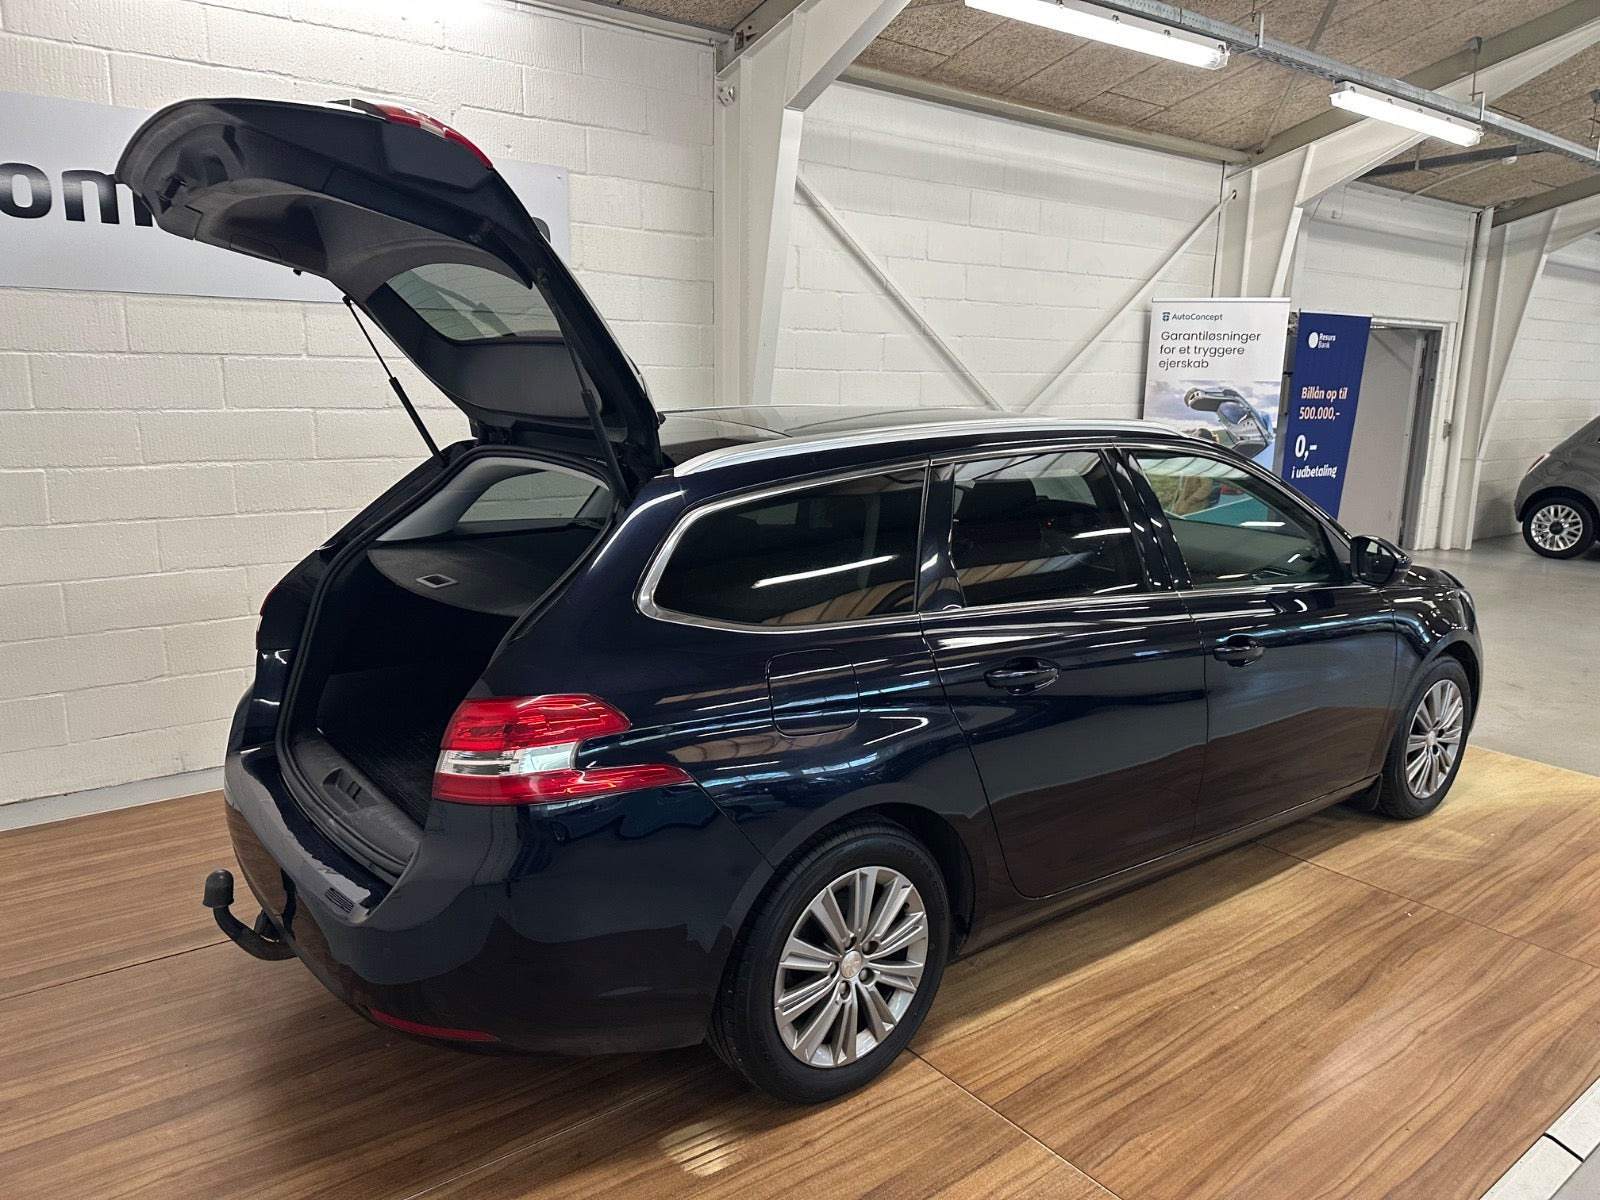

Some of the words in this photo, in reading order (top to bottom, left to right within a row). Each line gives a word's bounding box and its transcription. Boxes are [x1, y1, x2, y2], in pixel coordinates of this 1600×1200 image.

[1172, 313, 1223, 322] AutoConcept
[1161, 331, 1261, 344] Garantiløsninger
[1319, 332, 1336, 342] Resurs
[1160, 344, 1176, 355] for
[1178, 345, 1191, 355] et
[1194, 345, 1245, 358] tryggere
[1318, 340, 1331, 349] Bank
[1158, 359, 1209, 371] ejerskab
[1301, 386, 1325, 400] Billån
[1326, 389, 1337, 403] op
[1339, 387, 1348, 400] til
[1299, 406, 1341, 421] 500.000,-
[1295, 434, 1317, 461] 0,-
[1291, 466, 1296, 479] i
[1296, 464, 1338, 479] udbetaling
